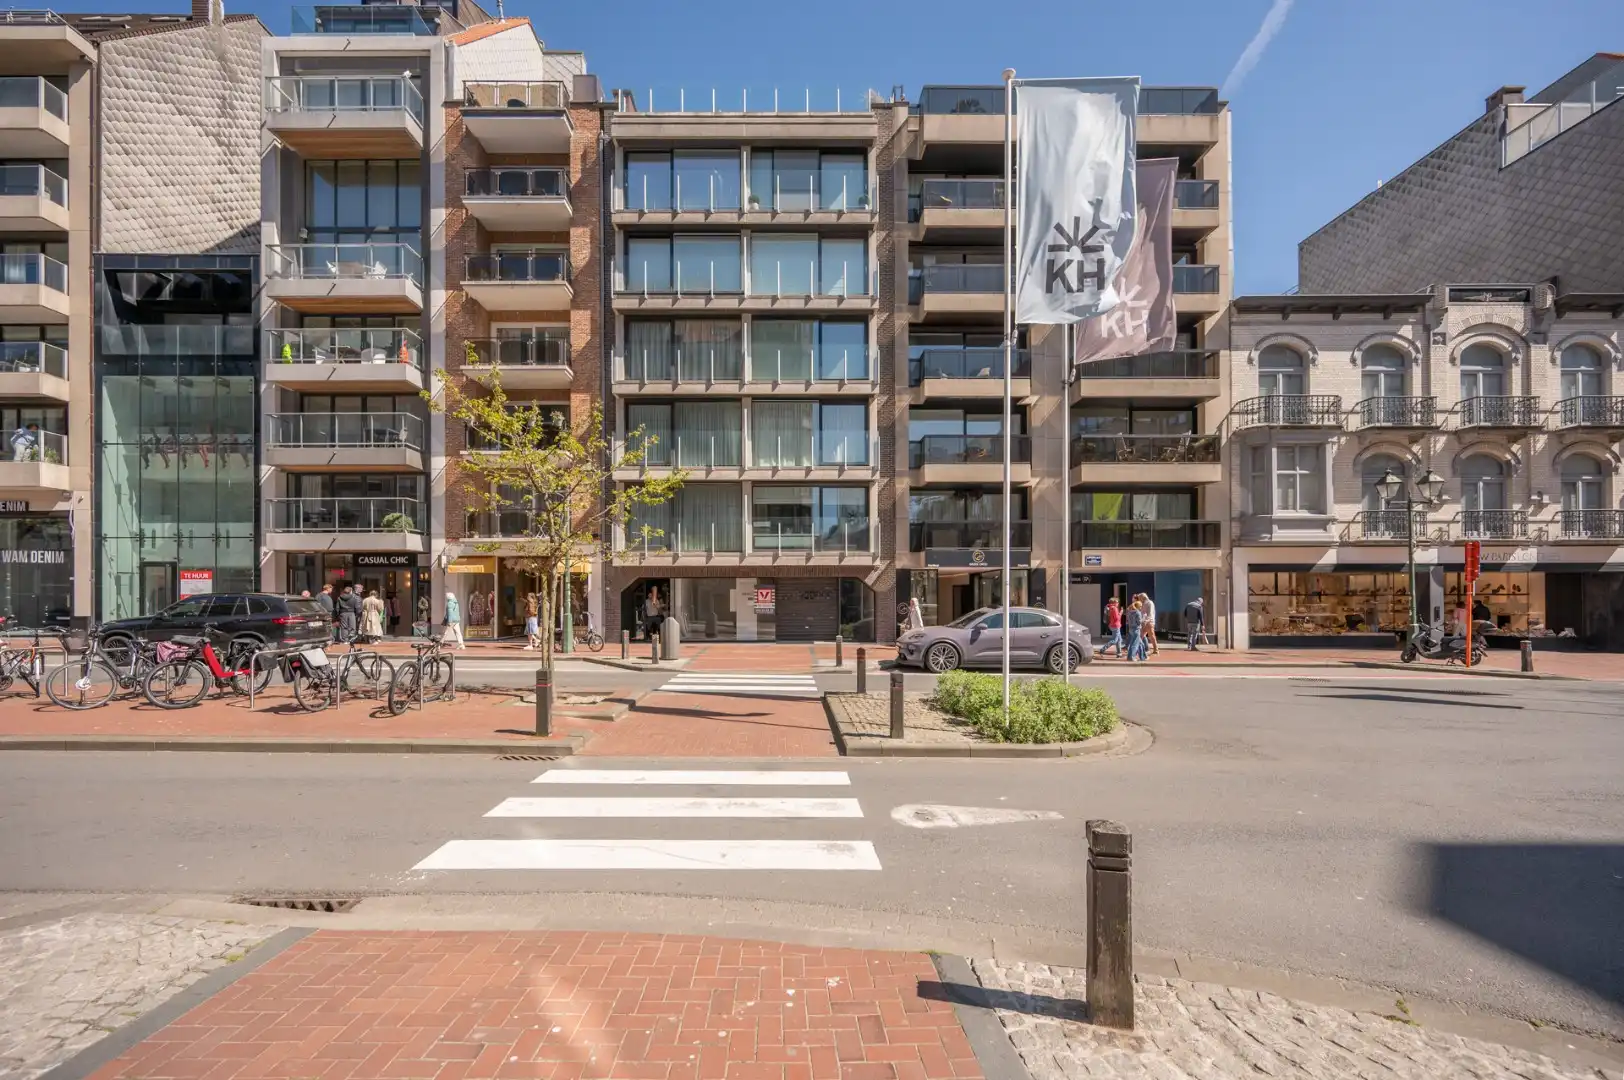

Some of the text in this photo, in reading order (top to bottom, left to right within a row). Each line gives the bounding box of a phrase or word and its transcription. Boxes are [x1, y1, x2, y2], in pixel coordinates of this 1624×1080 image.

[1045, 258, 1105, 294] KH
[1101, 310, 1149, 338] KH
[0, 500, 26, 512] ENIM
[2, 550, 65, 563] WAM DENIM
[358, 556, 409, 564] CASUAL CHIC
[1491, 552, 1516, 561] PARIS
